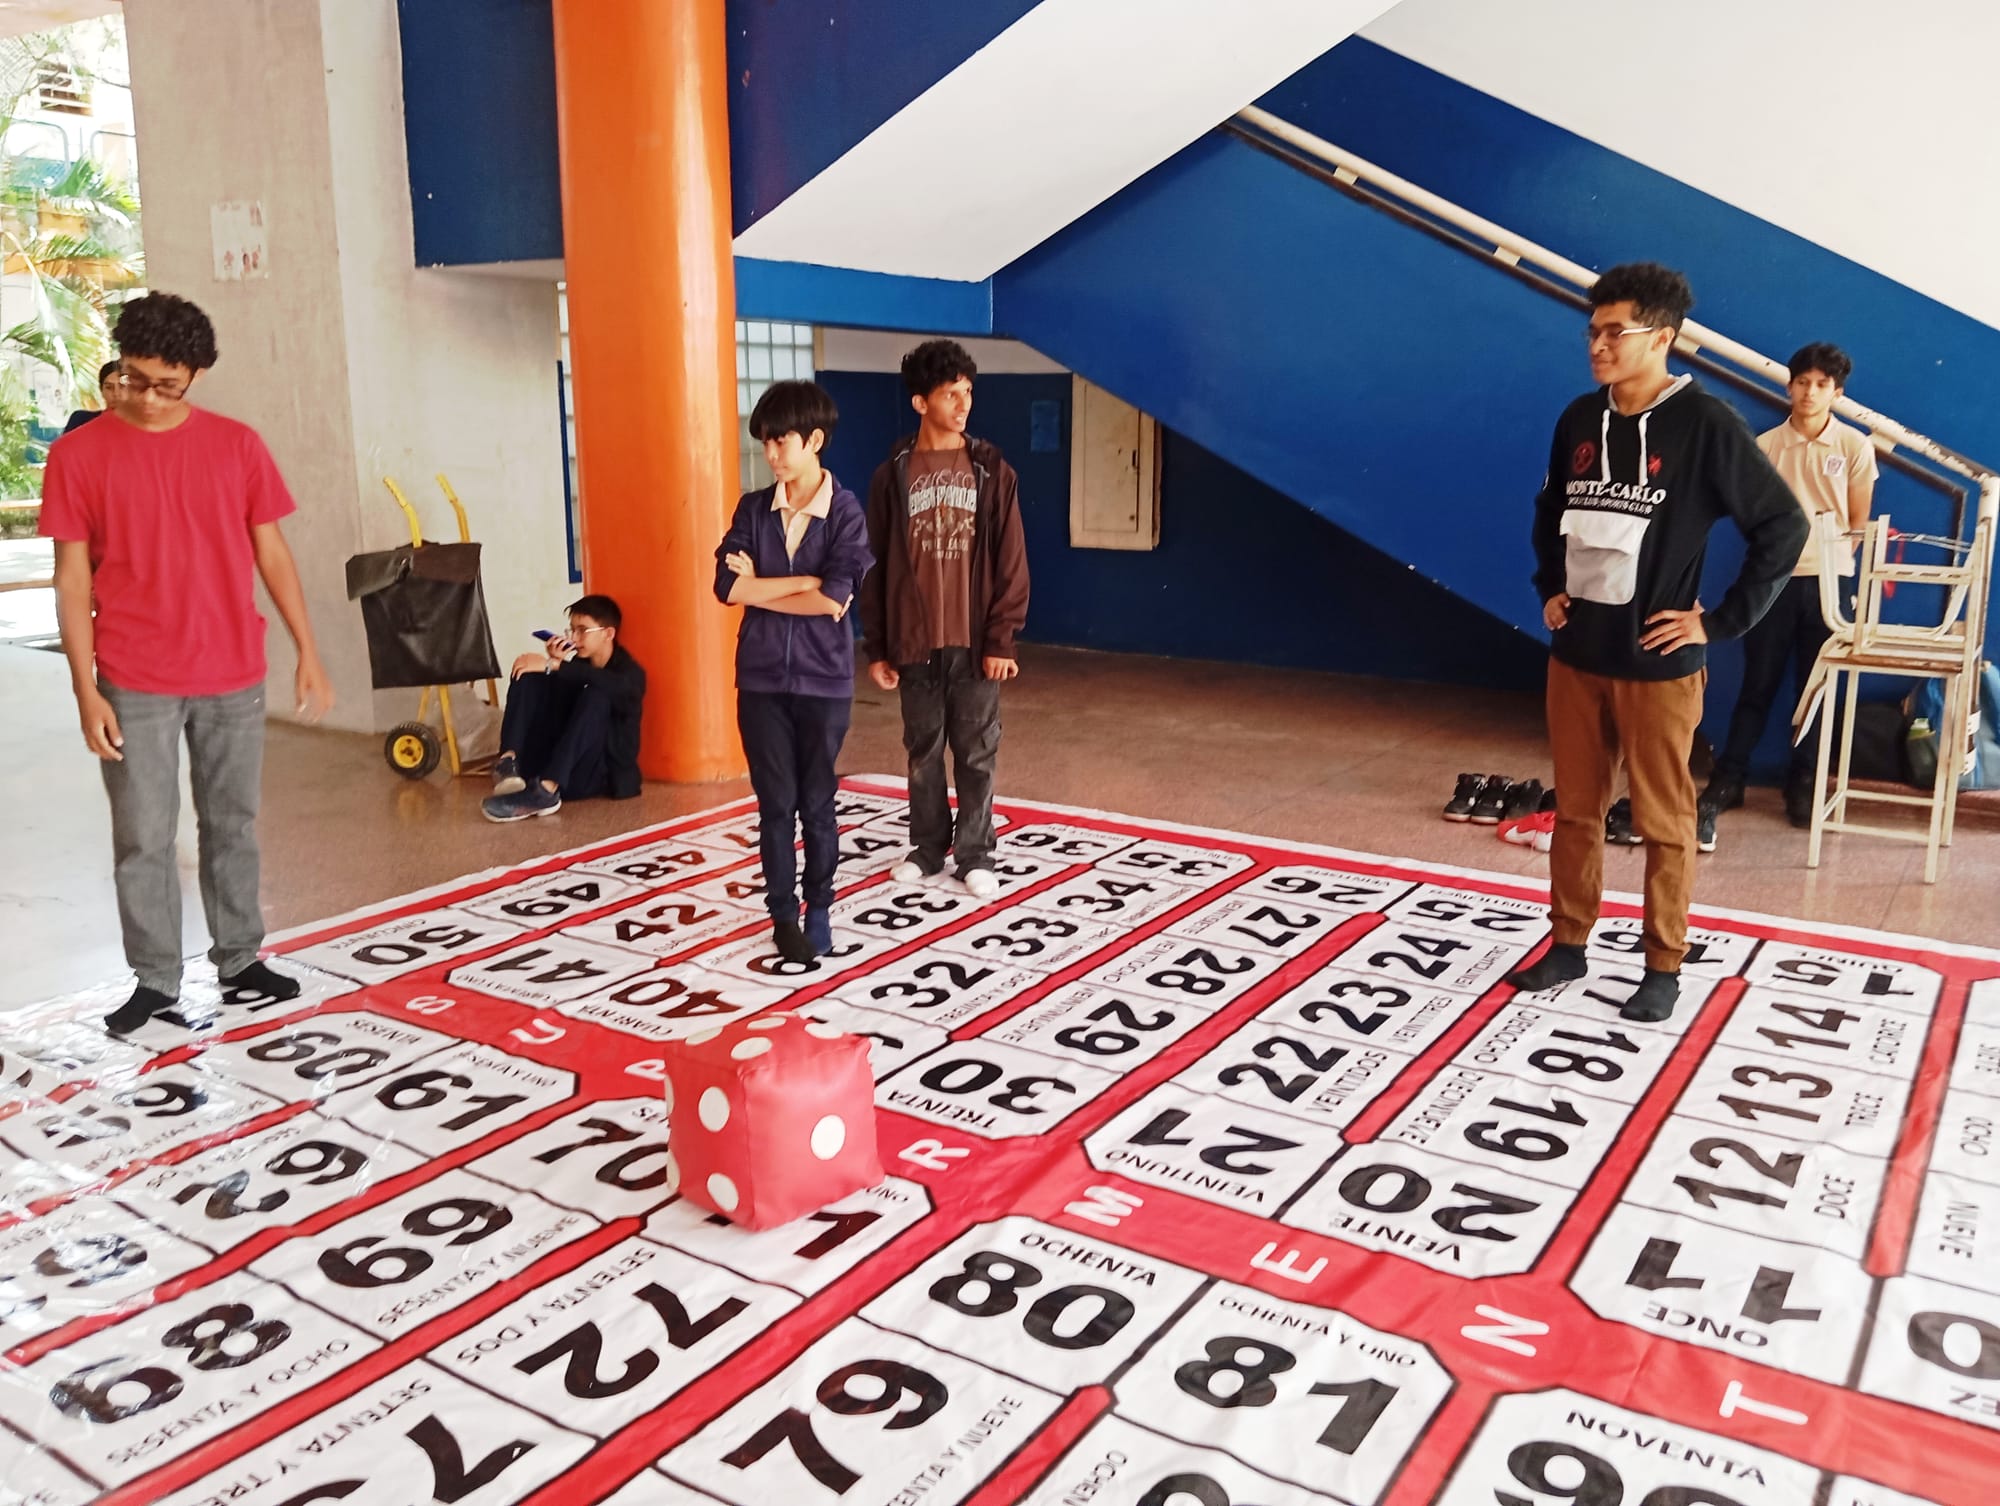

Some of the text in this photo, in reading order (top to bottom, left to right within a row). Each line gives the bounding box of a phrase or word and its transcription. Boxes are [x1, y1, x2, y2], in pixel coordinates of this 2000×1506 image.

[1566, 480, 1667, 505] MONTE-CARLO
[614, 850, 706, 880] 48
[1004, 832, 1107, 855] 36
[1117, 852, 1228, 877] 35
[501, 882, 600, 917] 49
[853, 893, 960, 930] 38
[1057, 879, 1156, 914] 34
[1263, 876, 1385, 905] 26
[1407, 899, 1541, 932] 25
[351, 925, 485, 965] 50
[615, 904, 721, 942] 42
[971, 917, 1079, 957] 33
[1227, 905, 1321, 947] 27
[483, 948, 609, 983] 41
[1145, 948, 1256, 995] 28
[1367, 933, 1472, 980] 24
[1772, 959, 1914, 996] 15
[609, 978, 741, 1018] 40
[870, 961, 998, 1008] 32
[1299, 980, 1412, 1036] 23
[1054, 999, 1176, 1055] 29
[1755, 1001, 1862, 1051] 14
[248, 1031, 390, 1081] 60
[1217, 1036, 1352, 1103] 22
[1527, 1028, 1641, 1082] 18
[375, 1070, 530, 1131] 61
[887, 1090, 998, 1130] TREINTA
[920, 1058, 1076, 1115] 30
[1716, 1064, 1833, 1123] 13
[532, 1117, 667, 1192] 70
[1127, 1108, 1304, 1175] 21
[1463, 1096, 1588, 1162] 19
[1105, 1149, 1265, 1202] VEINTIUNO
[1673, 1136, 1805, 1209] 12
[1813, 1174, 1855, 1219] DOCE
[1338, 1164, 1543, 1242] 20
[317, 1198, 513, 1289] 69
[1019, 1232, 1158, 1287] OCHENTA
[1329, 1210, 1462, 1262] VEINTE
[542, 1247, 656, 1313] SETENTA
[928, 1251, 1136, 1350] 80
[1625, 1236, 1823, 1325] 11
[456, 1327, 522, 1366] DOS
[513, 1281, 751, 1399] 72
[1219, 1296, 1329, 1336] OCHENTA
[1359, 1341, 1417, 1367] UNO
[1643, 1300, 1769, 1347] ONCE
[49, 1303, 292, 1424] 68
[106, 1400, 242, 1464] SESENTA
[268, 1339, 350, 1385] OCHO
[298, 1378, 433, 1454] SETENTA
[1174, 1336, 1400, 1455] 81
[719, 1358, 949, 1496] 79
[957, 1394, 1024, 1453] NUEVE
[1566, 1410, 1766, 1486] NOVENTA
